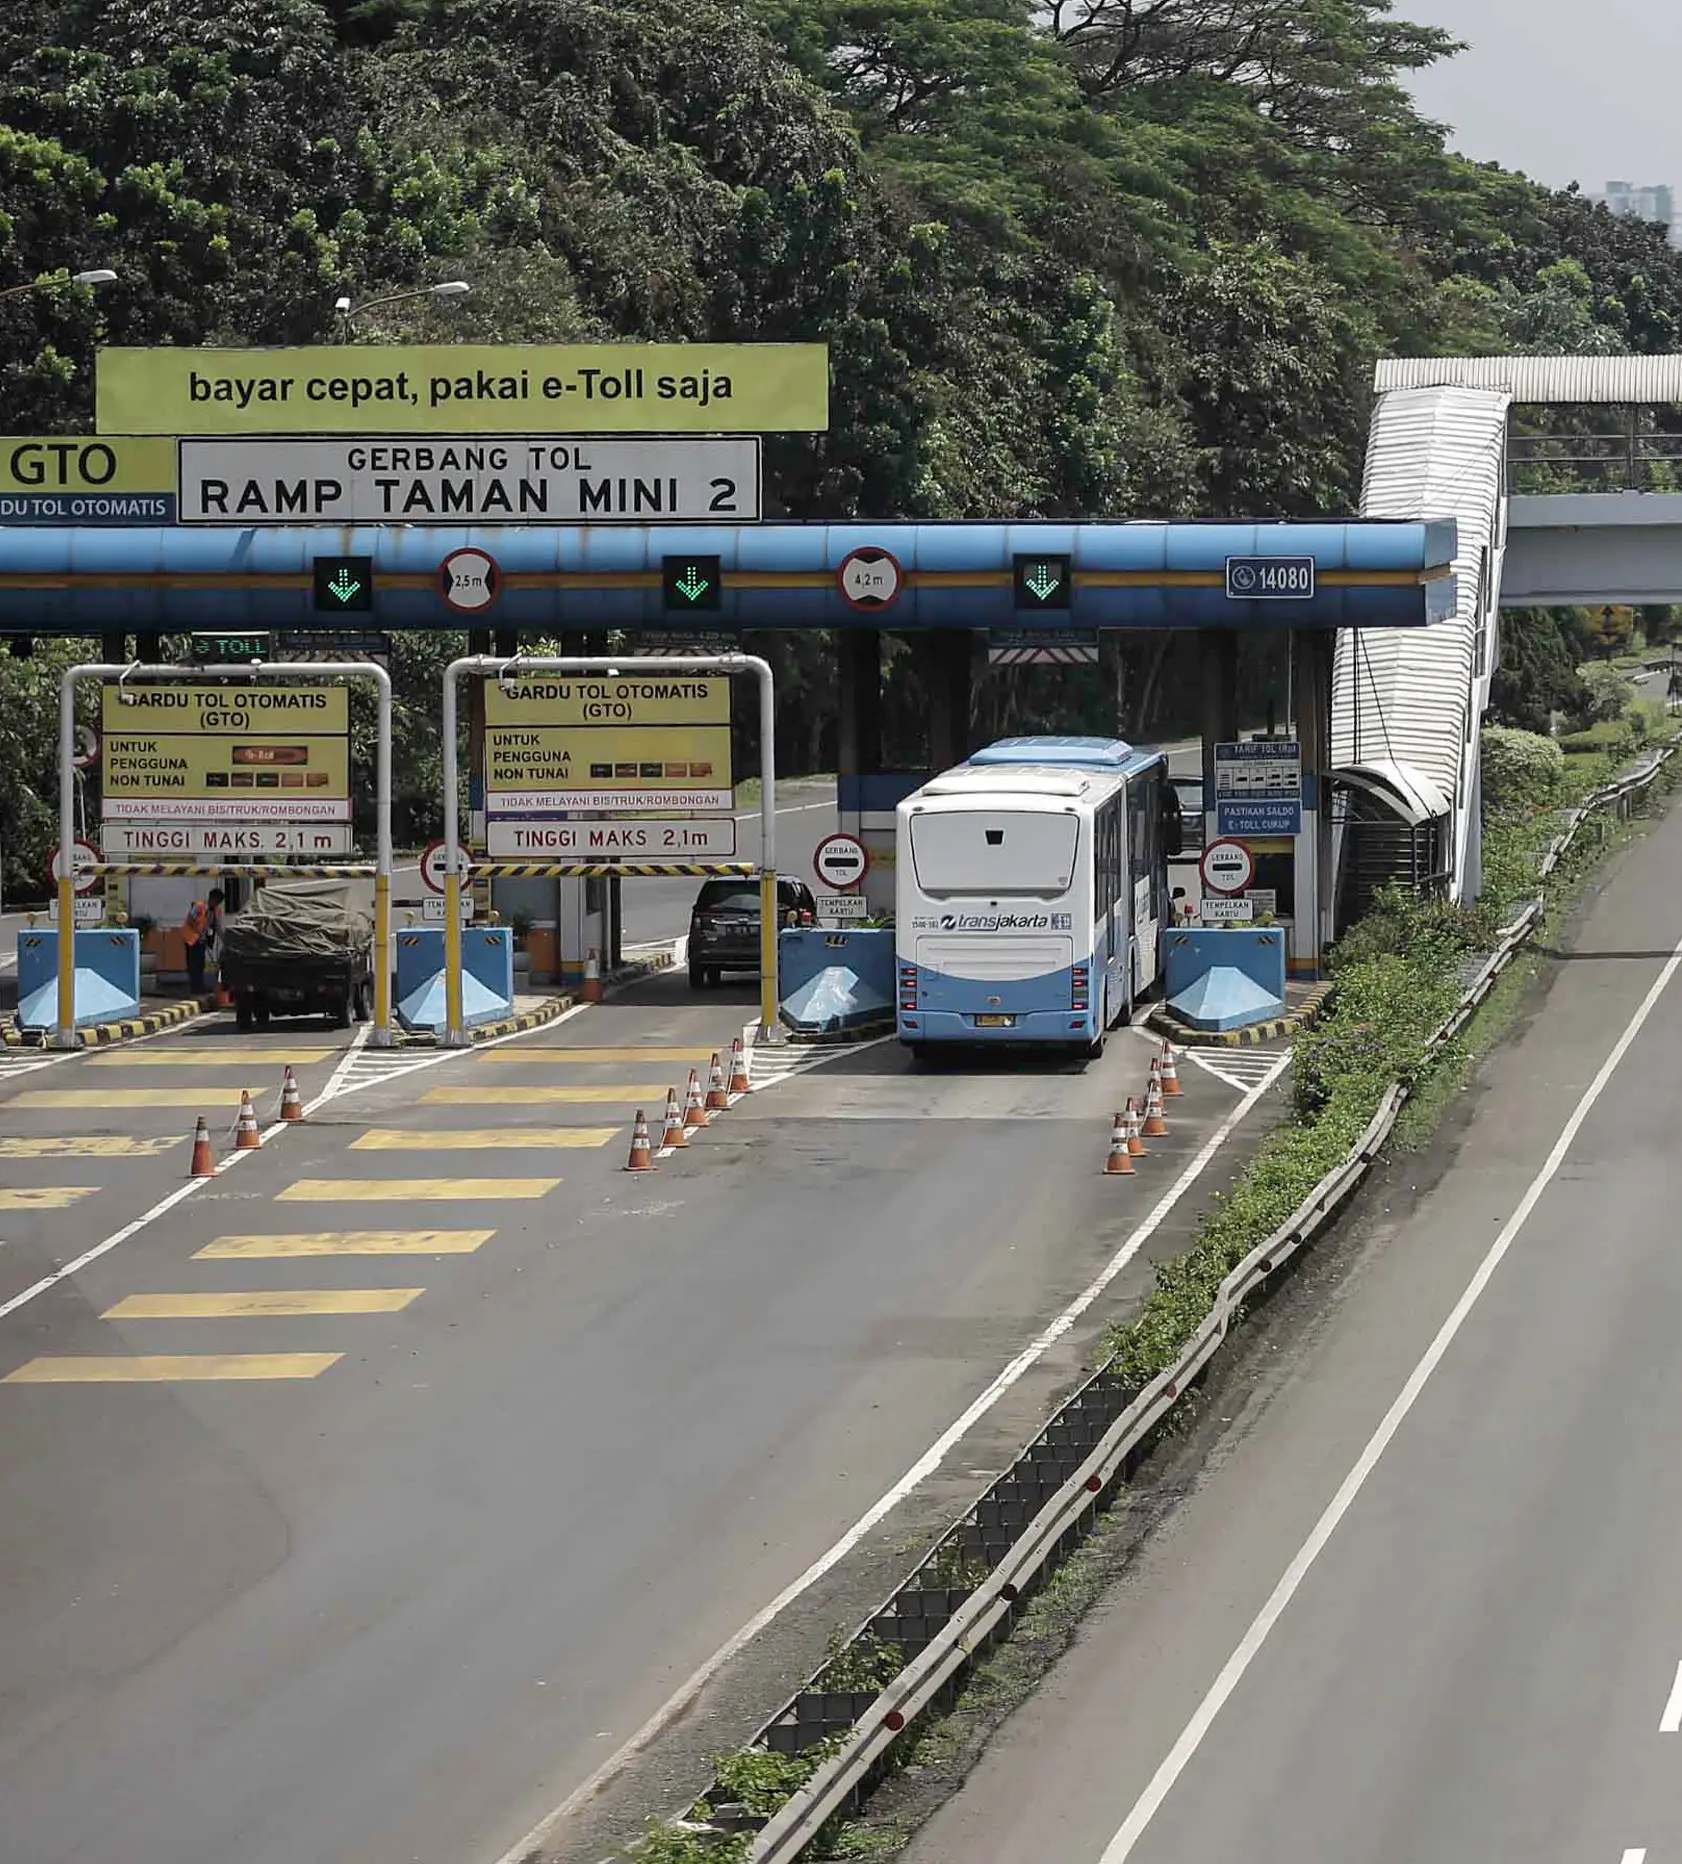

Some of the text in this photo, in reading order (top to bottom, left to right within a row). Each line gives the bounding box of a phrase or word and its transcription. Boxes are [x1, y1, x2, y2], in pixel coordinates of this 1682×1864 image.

[190, 369, 732, 409] bayar cepat, pakai e-Toll saja
[10, 443, 117, 485] GTO
[348, 447, 592, 471] GERBANG TOL
[201, 478, 738, 514] RAMP TAMAN MINI 2
[32, 500, 65, 515] TOL
[71, 499, 166, 515] OTOMATIS
[1260, 566, 1308, 589] 14080
[576, 685, 612, 699] TOL
[616, 684, 708, 699] OTOMATIS
[195, 693, 228, 708] TOL
[234, 693, 326, 708] OTOMATIS
[200, 711, 250, 729] (GTO)
[582, 702, 633, 721] (GTO)
[110, 741, 157, 753] UNTUK
[493, 735, 540, 746] UNTUK
[110, 758, 188, 769] PENGGUNA
[493, 751, 571, 762] PENGGUNA
[110, 775, 186, 787] NON TUNAI
[494, 768, 569, 780] NON TUNAI
[124, 831, 190, 848] TINGGI
[313, 835, 333, 849] m
[513, 830, 577, 848] TINGGI
[589, 830, 647, 847] MAKS
[958, 914, 1048, 931] transjakarta
